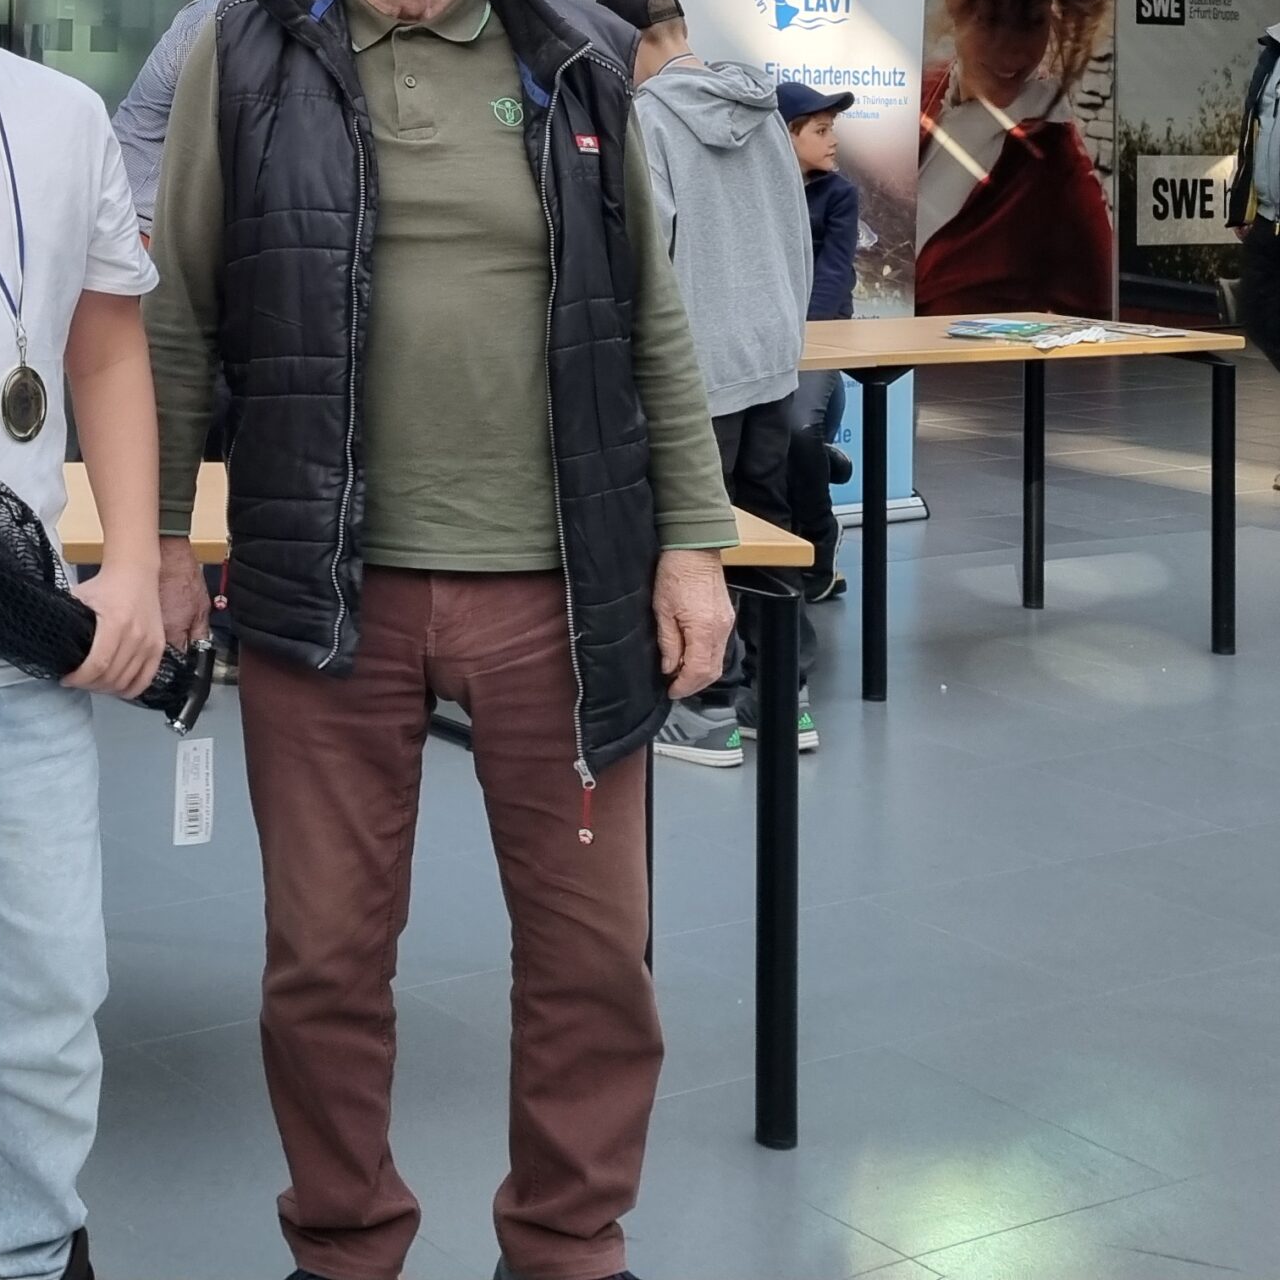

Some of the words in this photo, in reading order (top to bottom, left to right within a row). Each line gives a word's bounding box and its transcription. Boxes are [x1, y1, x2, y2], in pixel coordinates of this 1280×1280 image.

[1188, 6, 1211, 19] Erfurt
[1212, 7, 1240, 22] Gruppe
[765, 62, 906, 87] Fischartenschutz
[862, 95, 898, 107] Thüringen
[1152, 177, 1214, 221] SWE
